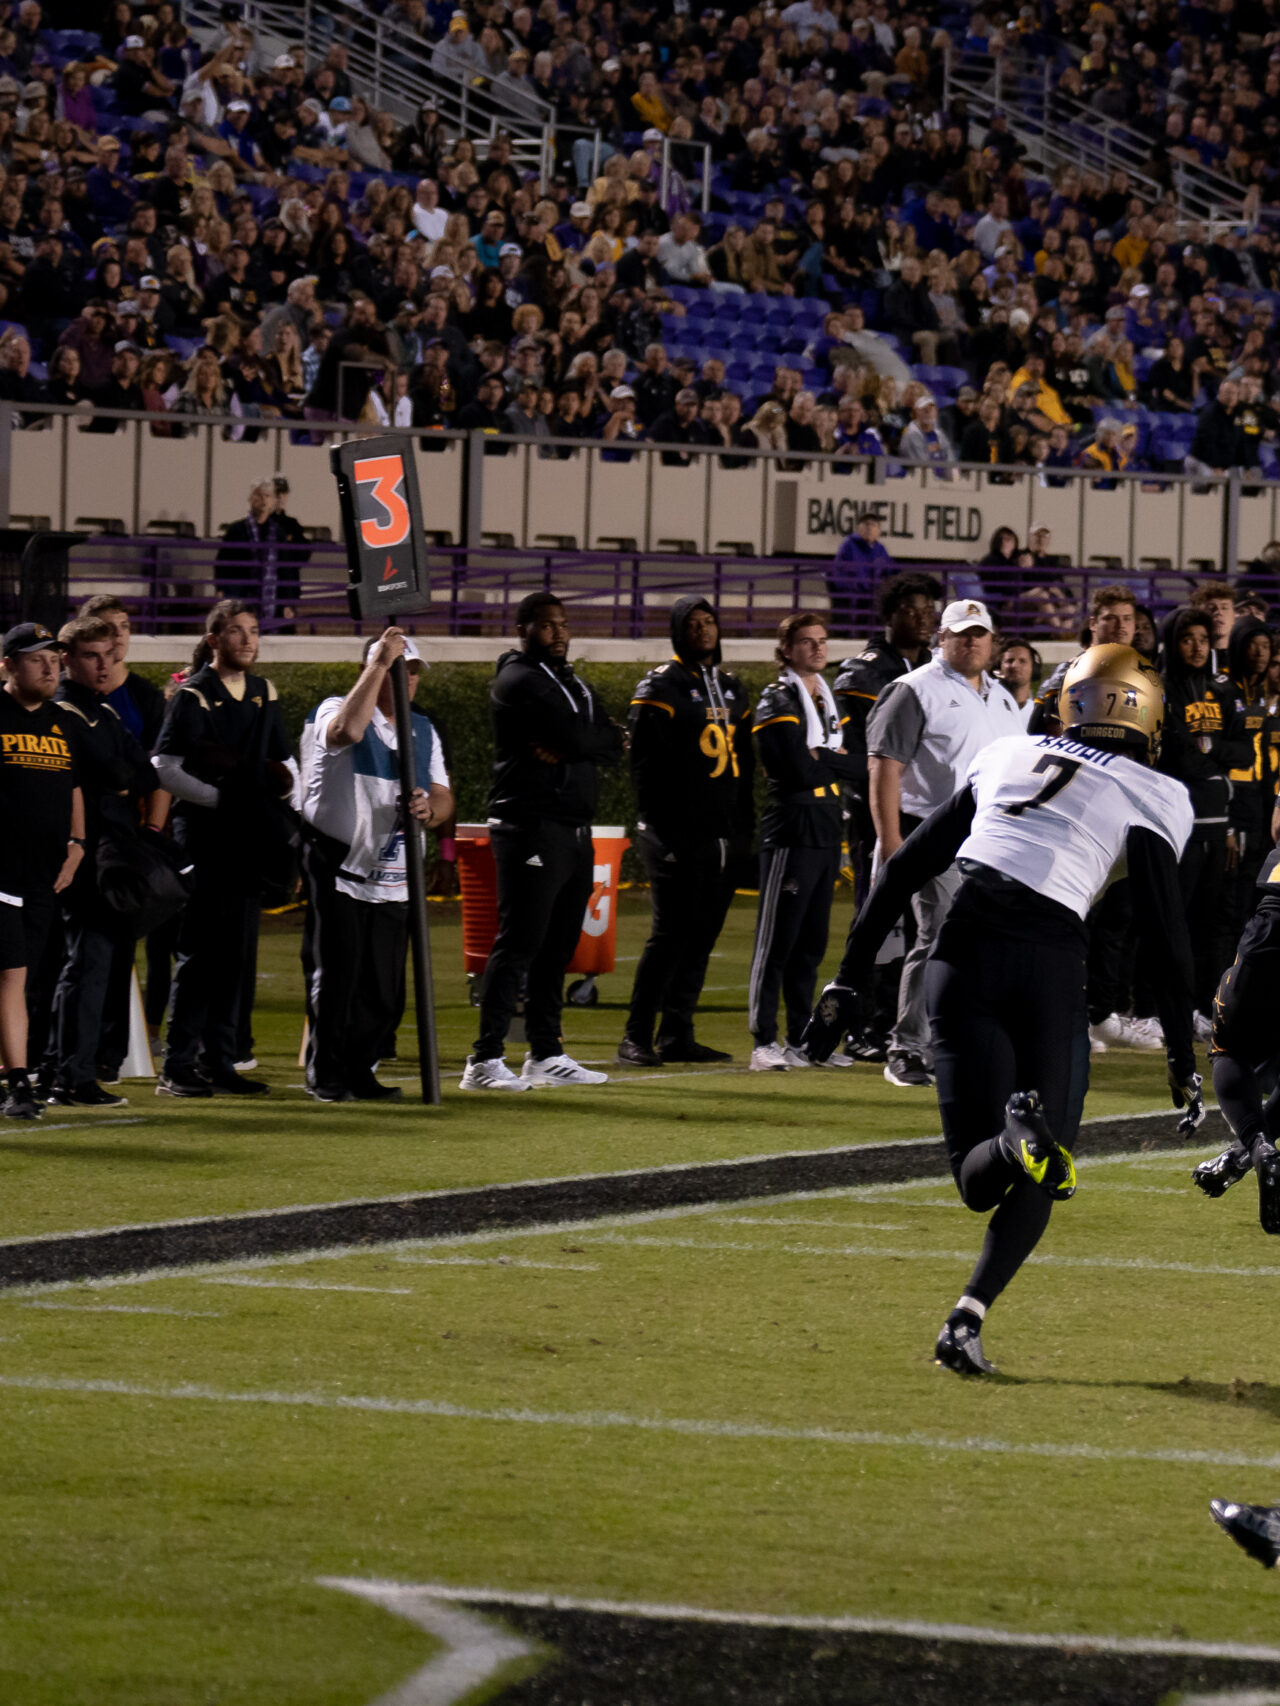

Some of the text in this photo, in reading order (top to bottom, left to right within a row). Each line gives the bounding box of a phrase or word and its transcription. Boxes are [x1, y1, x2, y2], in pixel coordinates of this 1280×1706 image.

[354, 454, 411, 548] 3
[924, 504, 982, 542] FIELD
[1106, 693, 1117, 716] 7
[0, 733, 71, 758] PIRATE
[1004, 753, 1083, 816] 7
